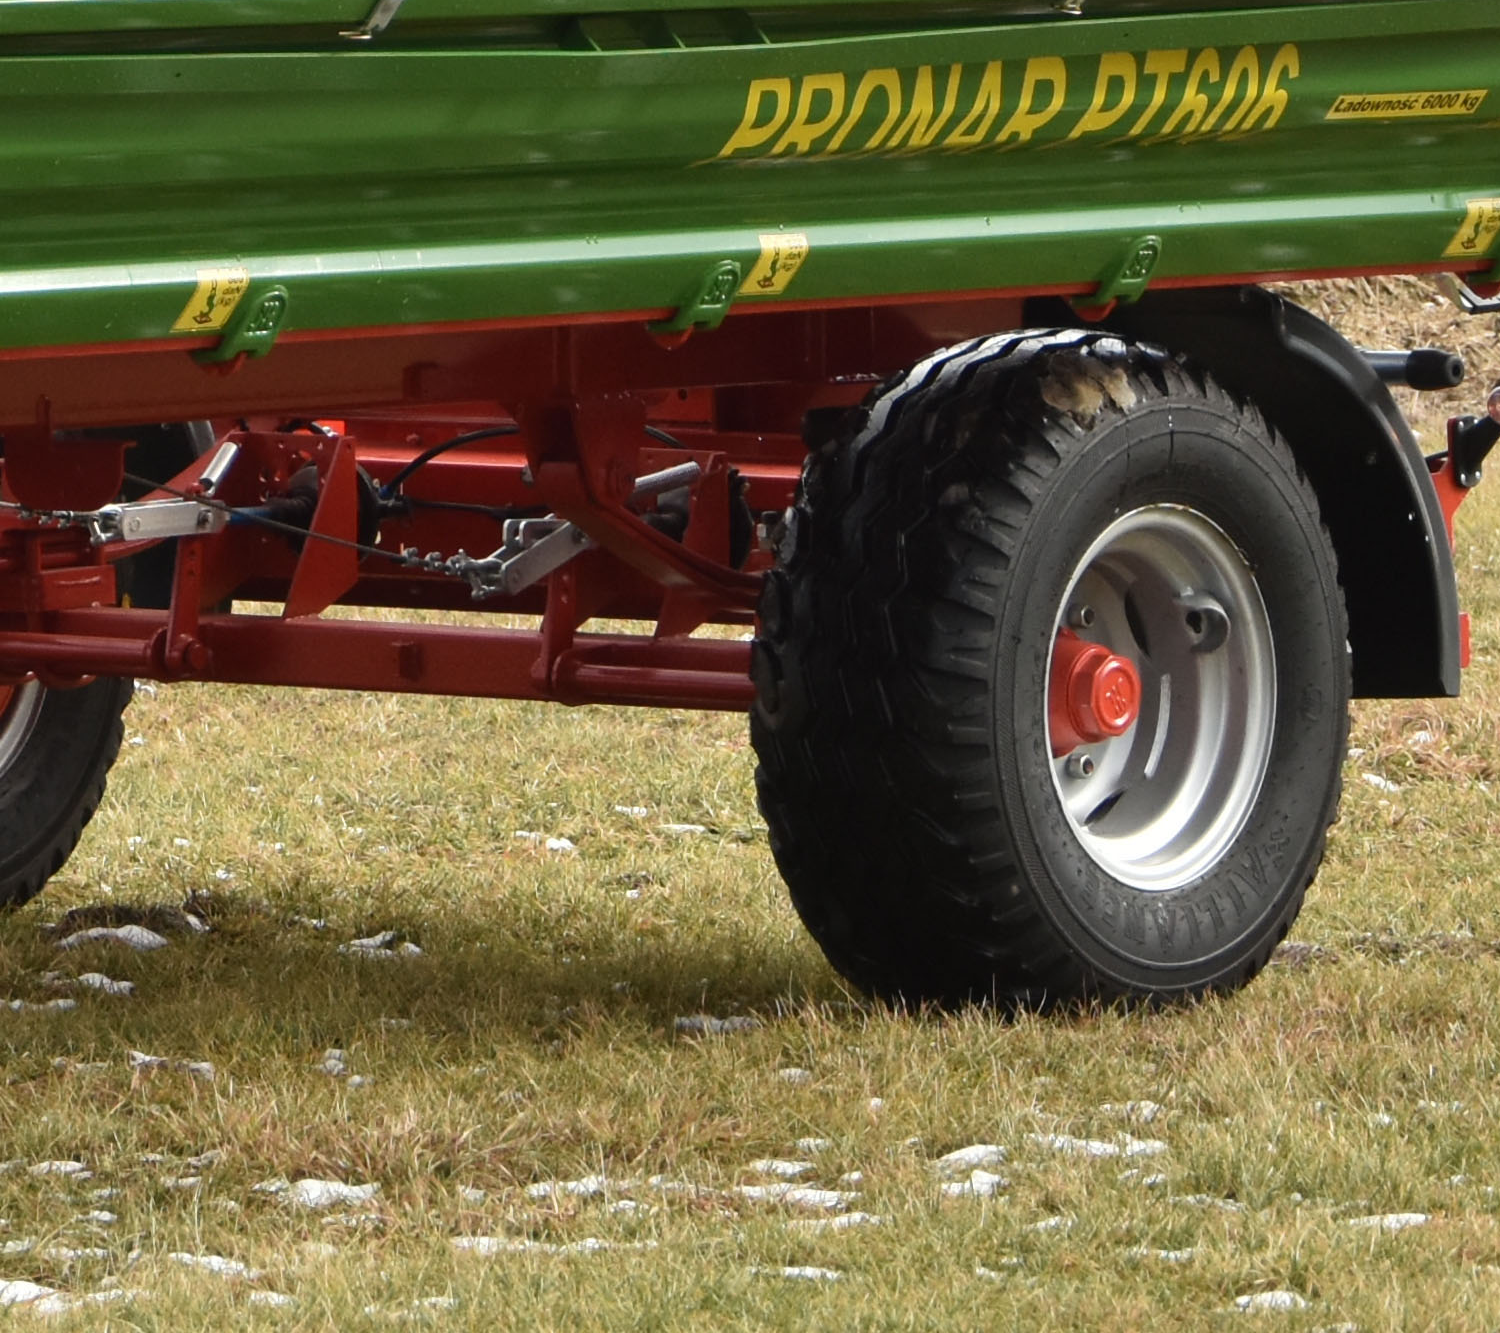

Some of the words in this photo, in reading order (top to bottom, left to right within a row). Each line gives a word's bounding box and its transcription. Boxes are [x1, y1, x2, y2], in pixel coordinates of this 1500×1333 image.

[717, 60, 1068, 159] PRONAR
[1333, 95, 1418, 113] Ładowność
[1421, 93, 1458, 109] 6000
[1461, 93, 1481, 110] kg
